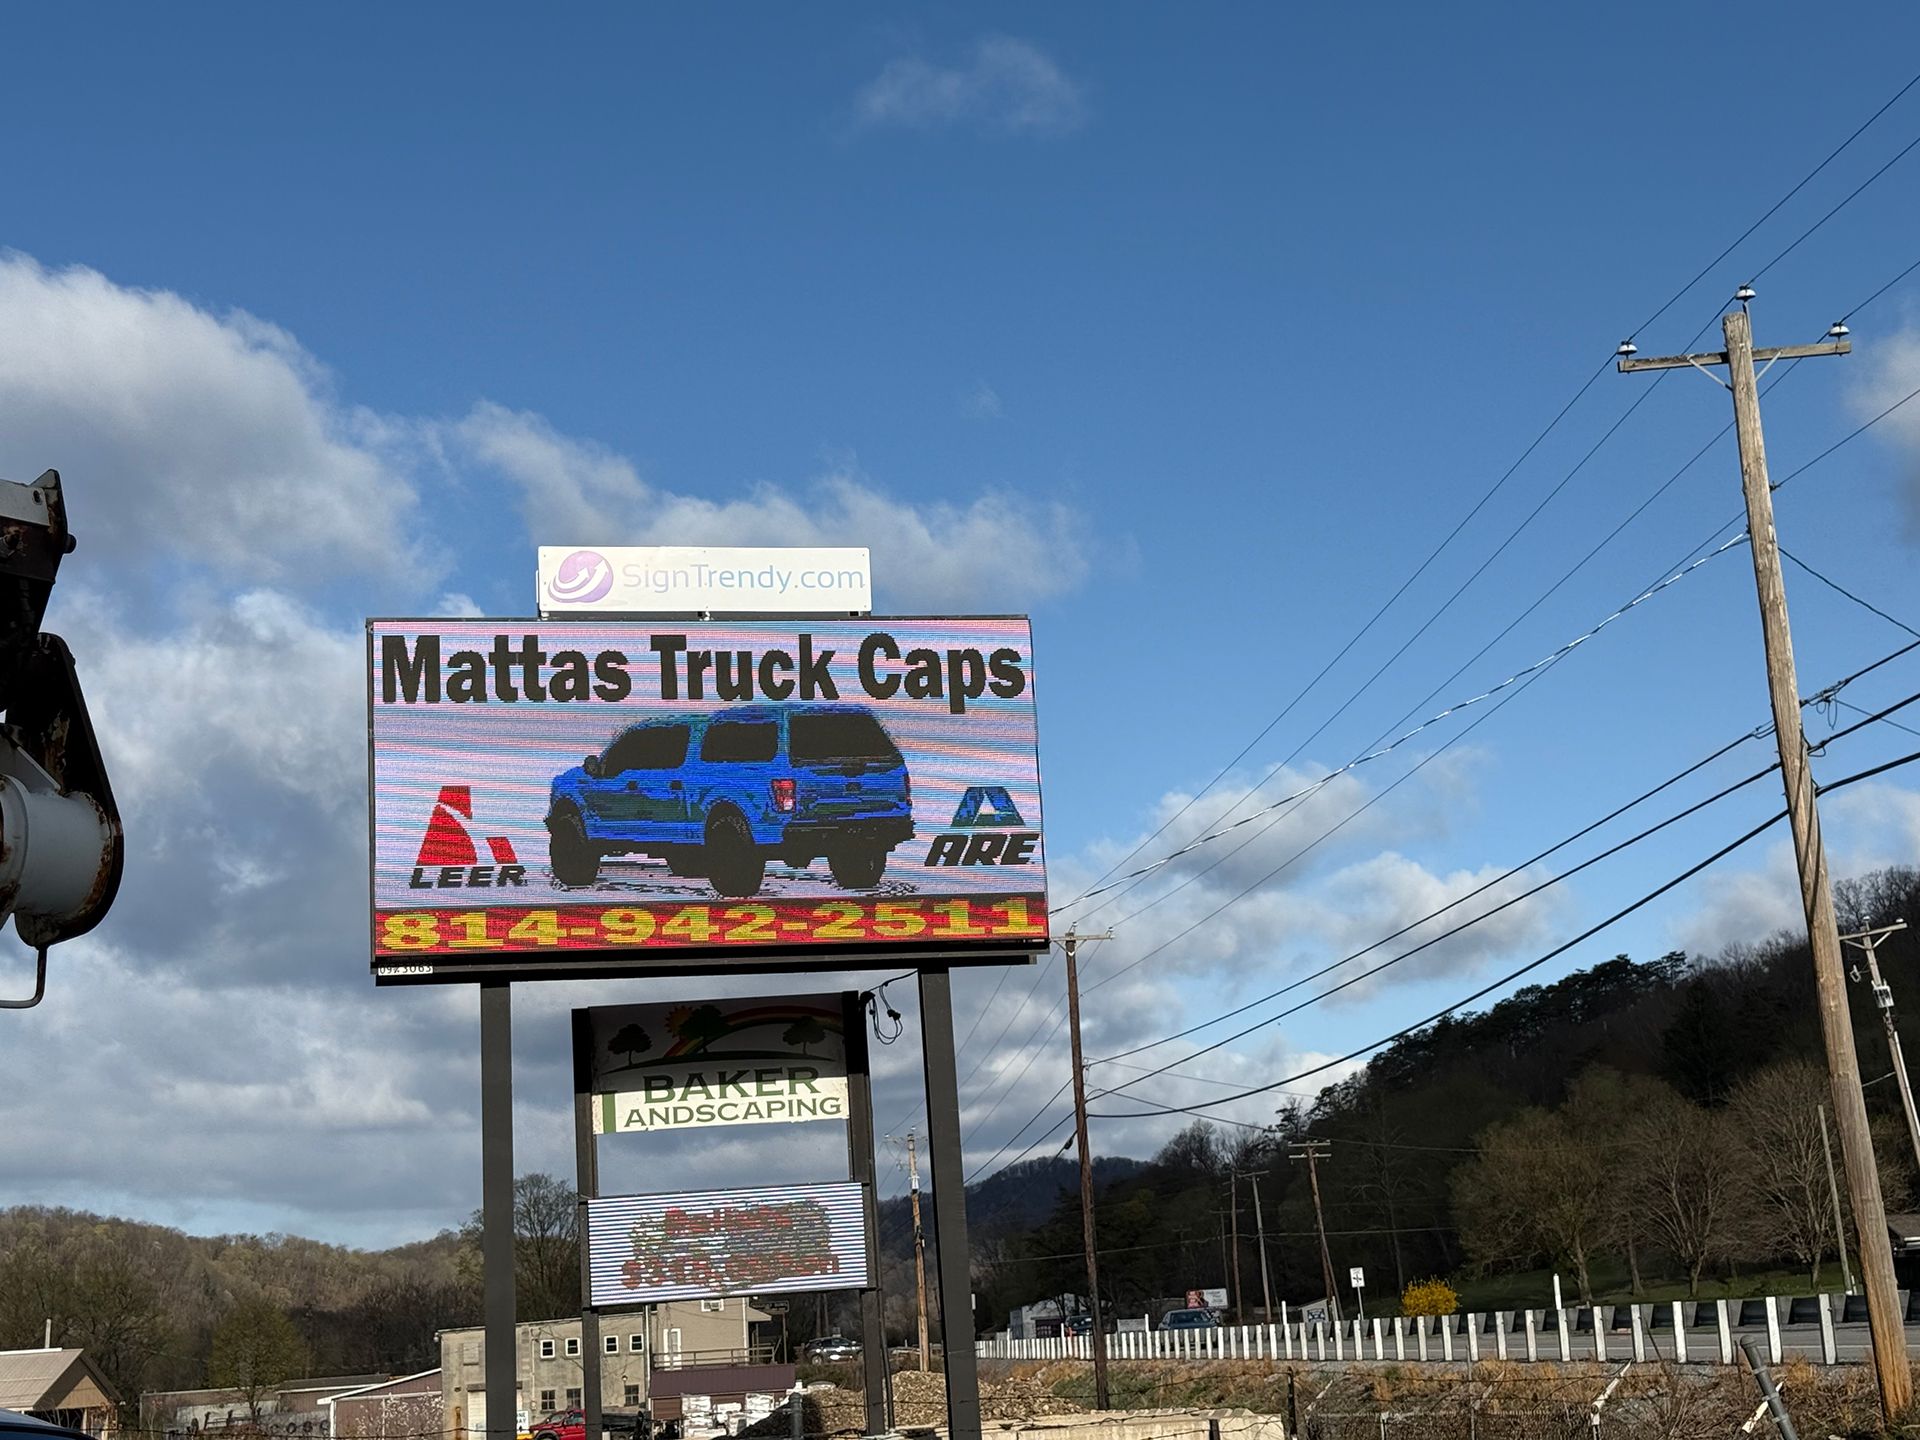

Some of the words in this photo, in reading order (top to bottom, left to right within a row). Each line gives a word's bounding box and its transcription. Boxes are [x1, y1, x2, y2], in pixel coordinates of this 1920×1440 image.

[622, 563, 865, 594] SignTrendy.com
[381, 634, 632, 703] Mattas
[650, 633, 840, 701] Truck
[858, 631, 1026, 714] Caps
[924, 833, 1040, 867] ARE
[409, 865, 526, 889] LEER
[381, 897, 1045, 950] 814-942-2511
[643, 1065, 822, 1105] BAKER
